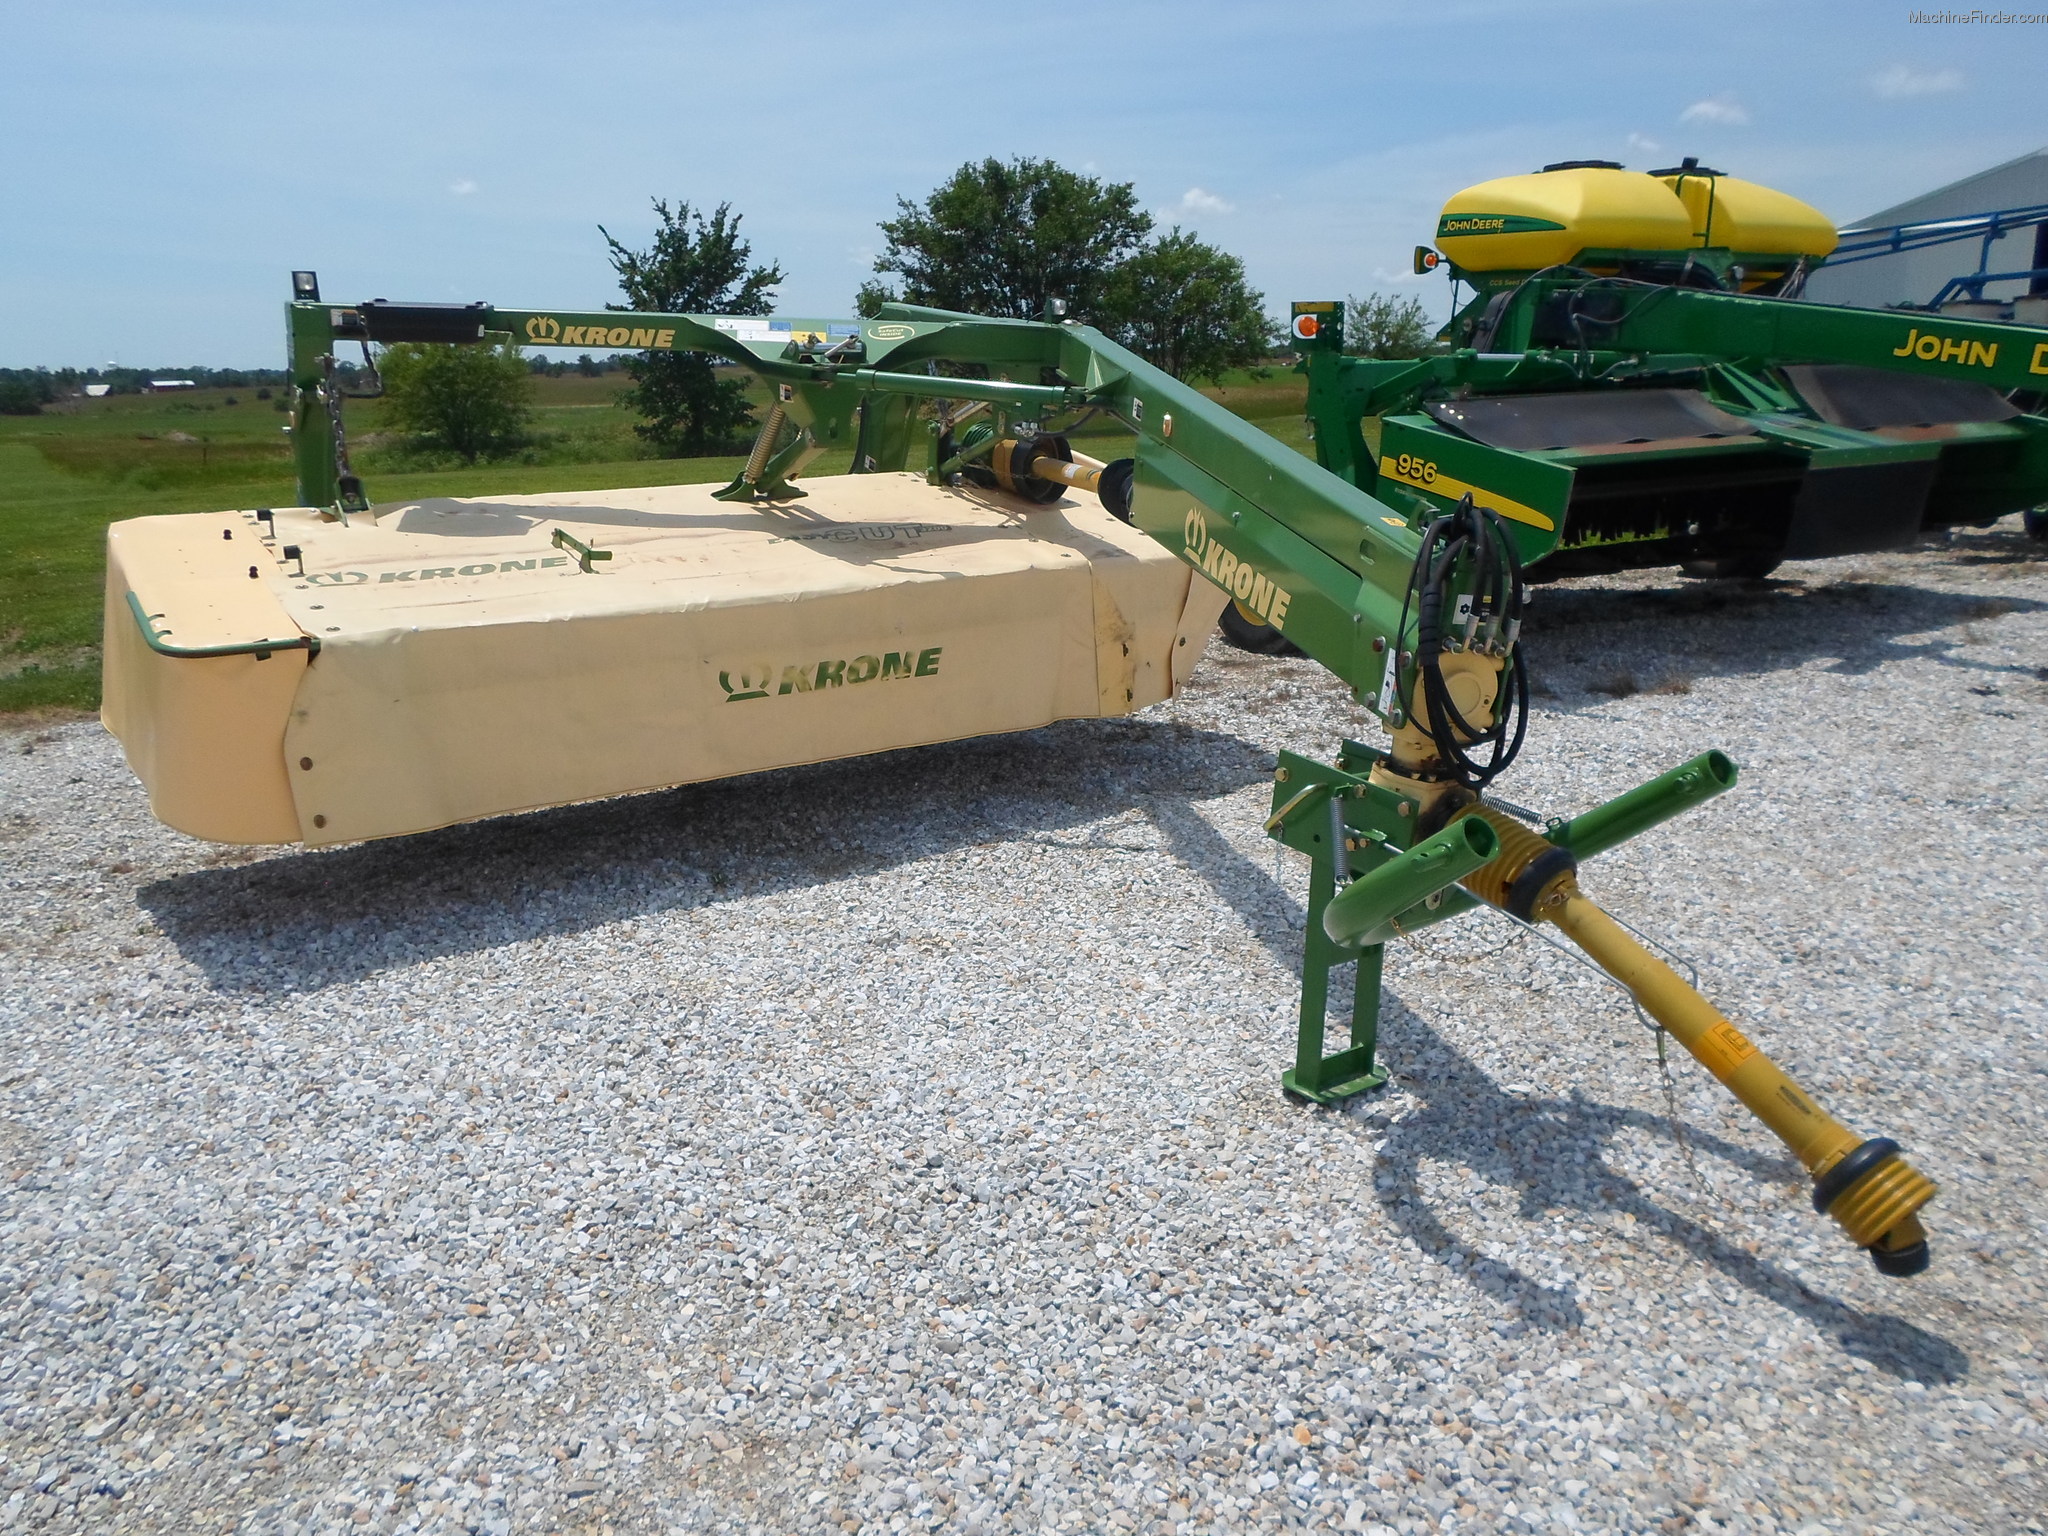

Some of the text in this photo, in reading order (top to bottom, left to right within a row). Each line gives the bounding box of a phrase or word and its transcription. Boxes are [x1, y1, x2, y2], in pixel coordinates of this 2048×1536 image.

[1444, 218, 1504, 231] JOHN DEERE
[562, 326, 676, 348] KRONE
[1893, 328, 1999, 368] JOHN
[1396, 453, 1438, 484] 956
[378, 556, 569, 584] KRONE
[1202, 537, 1292, 631] KRONE
[777, 646, 943, 696] KRONE
